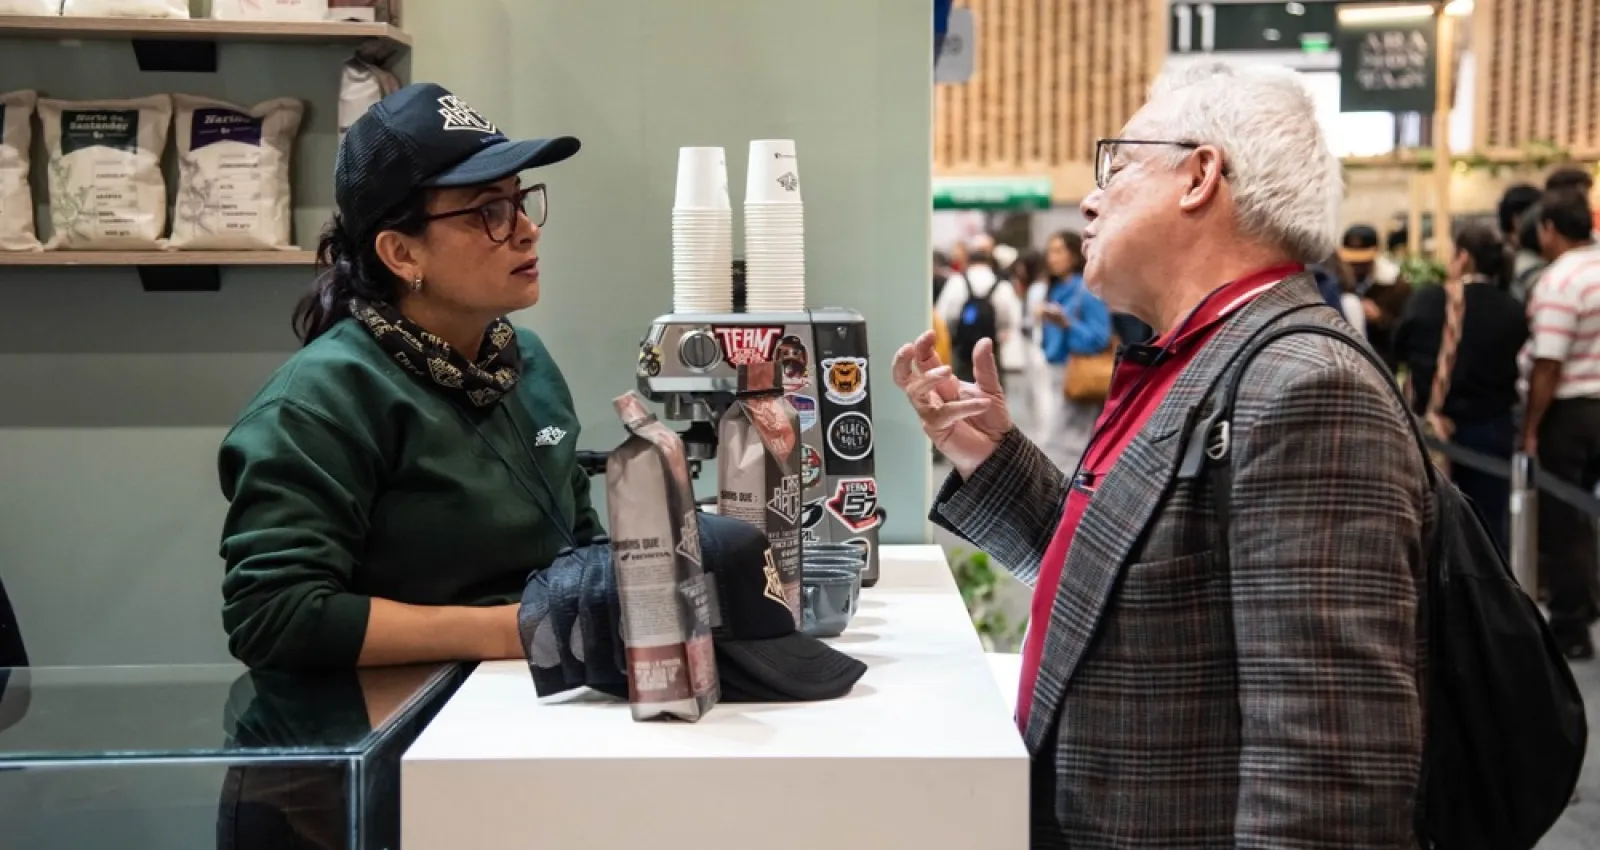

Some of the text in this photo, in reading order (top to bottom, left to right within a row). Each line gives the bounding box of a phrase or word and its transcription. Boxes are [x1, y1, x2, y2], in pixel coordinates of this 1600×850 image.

[1174, 3, 1215, 51] 11
[714, 327, 782, 360] TEAM
[839, 423, 865, 436] BLACK
[841, 435, 864, 447] BOLT
[842, 493, 878, 518] 57
